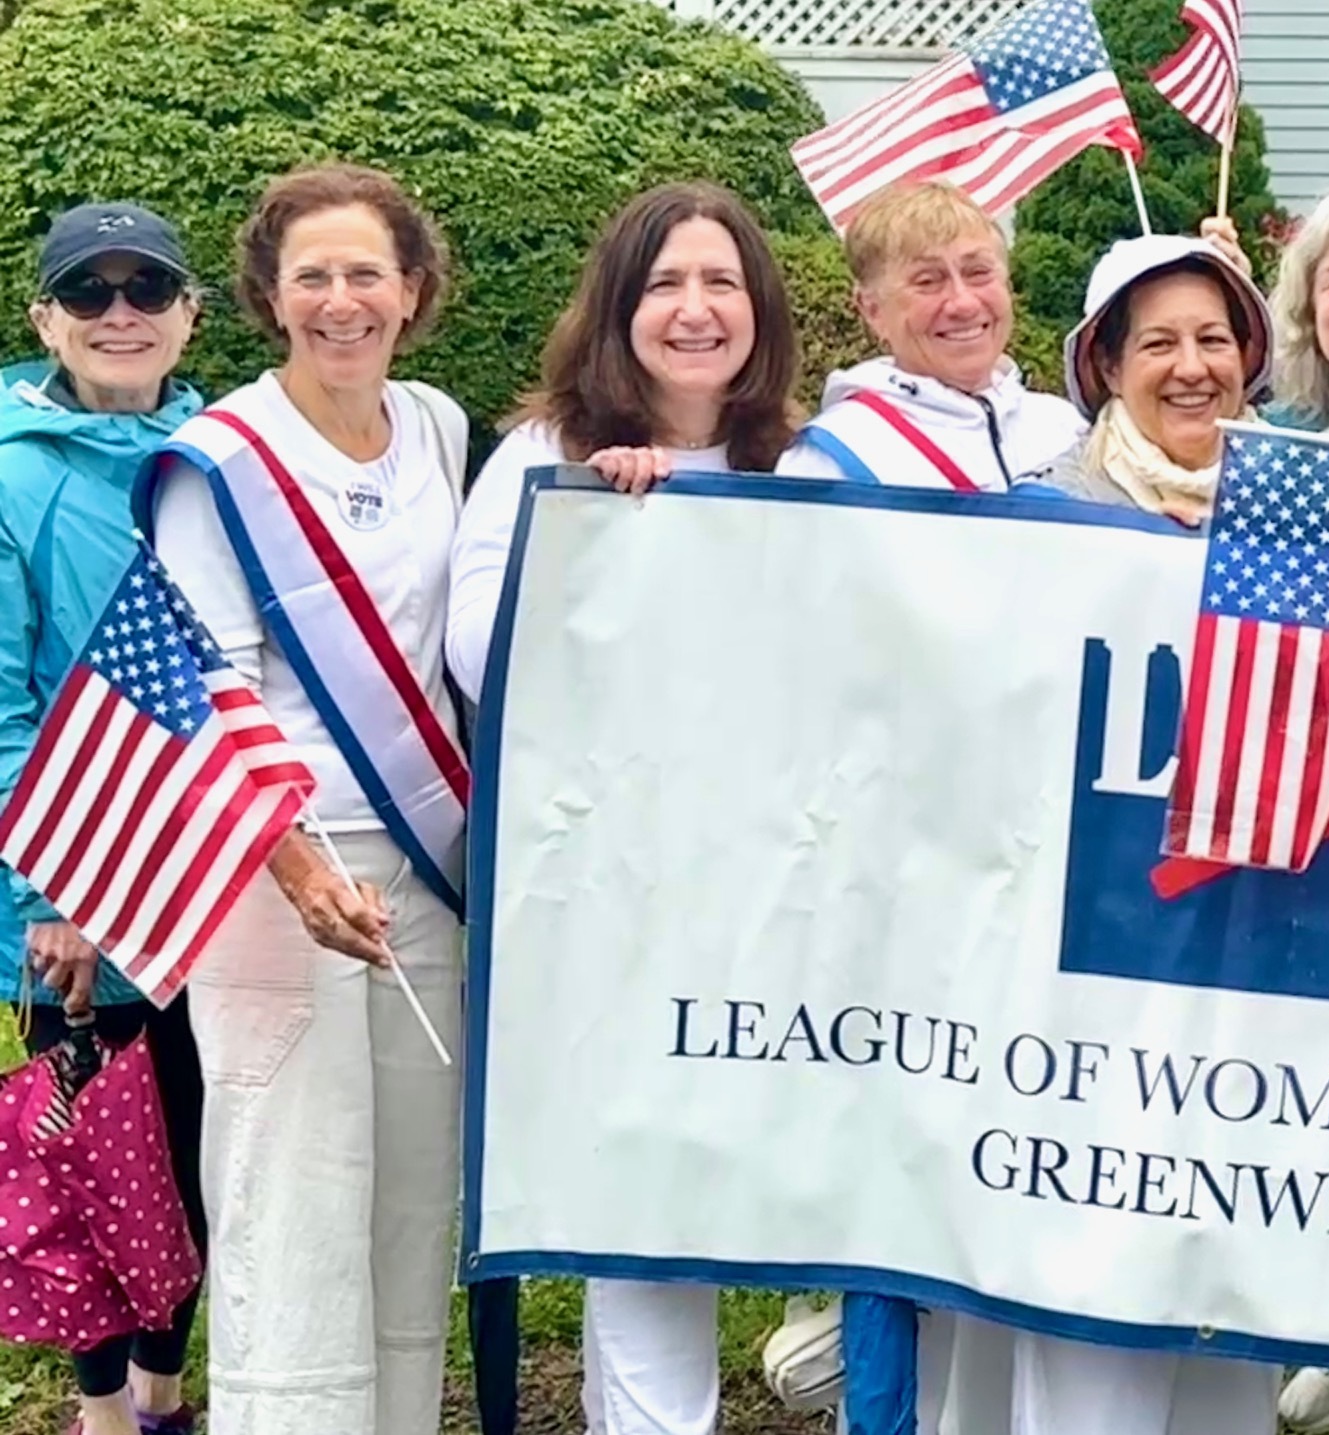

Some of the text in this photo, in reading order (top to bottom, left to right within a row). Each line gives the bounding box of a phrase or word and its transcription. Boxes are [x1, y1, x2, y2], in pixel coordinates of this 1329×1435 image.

[345, 489, 383, 508] VOTE
[668, 997, 980, 1085] LEAGUE
[1003, 1034, 1109, 1102] OF
